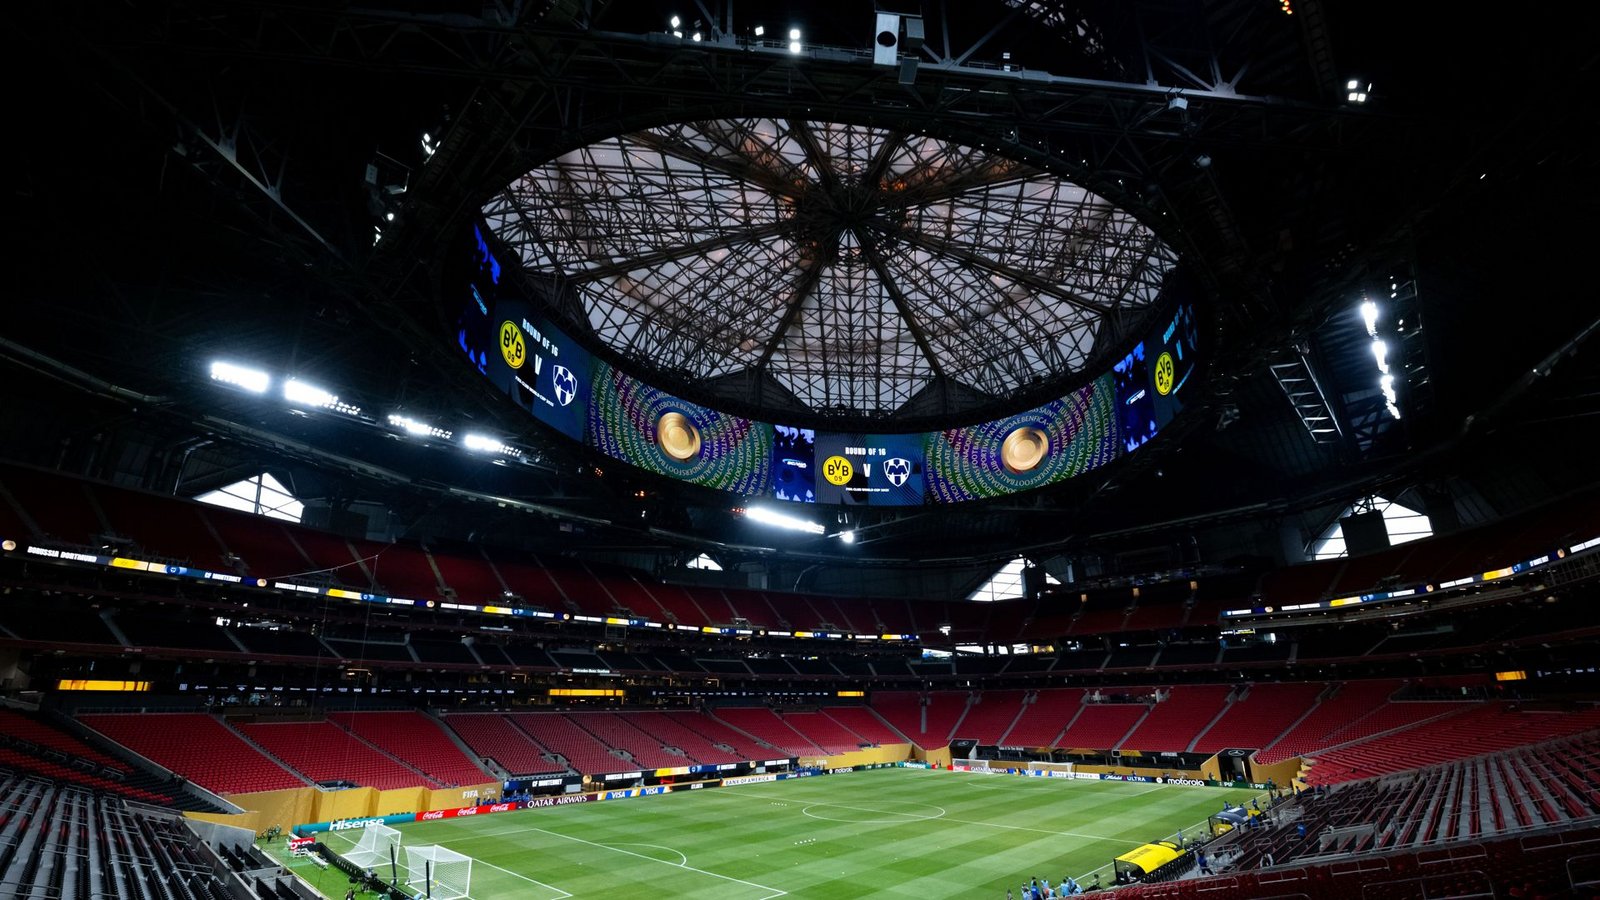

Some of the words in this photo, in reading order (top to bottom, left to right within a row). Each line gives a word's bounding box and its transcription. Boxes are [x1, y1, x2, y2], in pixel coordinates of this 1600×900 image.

[503, 326, 522, 359] BVB
[522, 318, 541, 342] ROUND
[542, 337, 550, 349] OF
[551, 344, 559, 357] 16
[1157, 357, 1172, 386] BVB
[947, 428, 958, 444] CLUB
[845, 447, 866, 455] ROUND
[878, 448, 886, 456] 16
[828, 459, 849, 476] BVB
[863, 463, 871, 477] V
[27, 546, 59, 557] BORUSSIA
[60, 551, 97, 563] DORTMUND
[1167, 778, 1205, 787] motorola
[463, 790, 478, 799] FIFA
[527, 798, 554, 808] QATAR
[556, 795, 587, 805] AIRWAYS
[328, 818, 385, 832] Hisense
